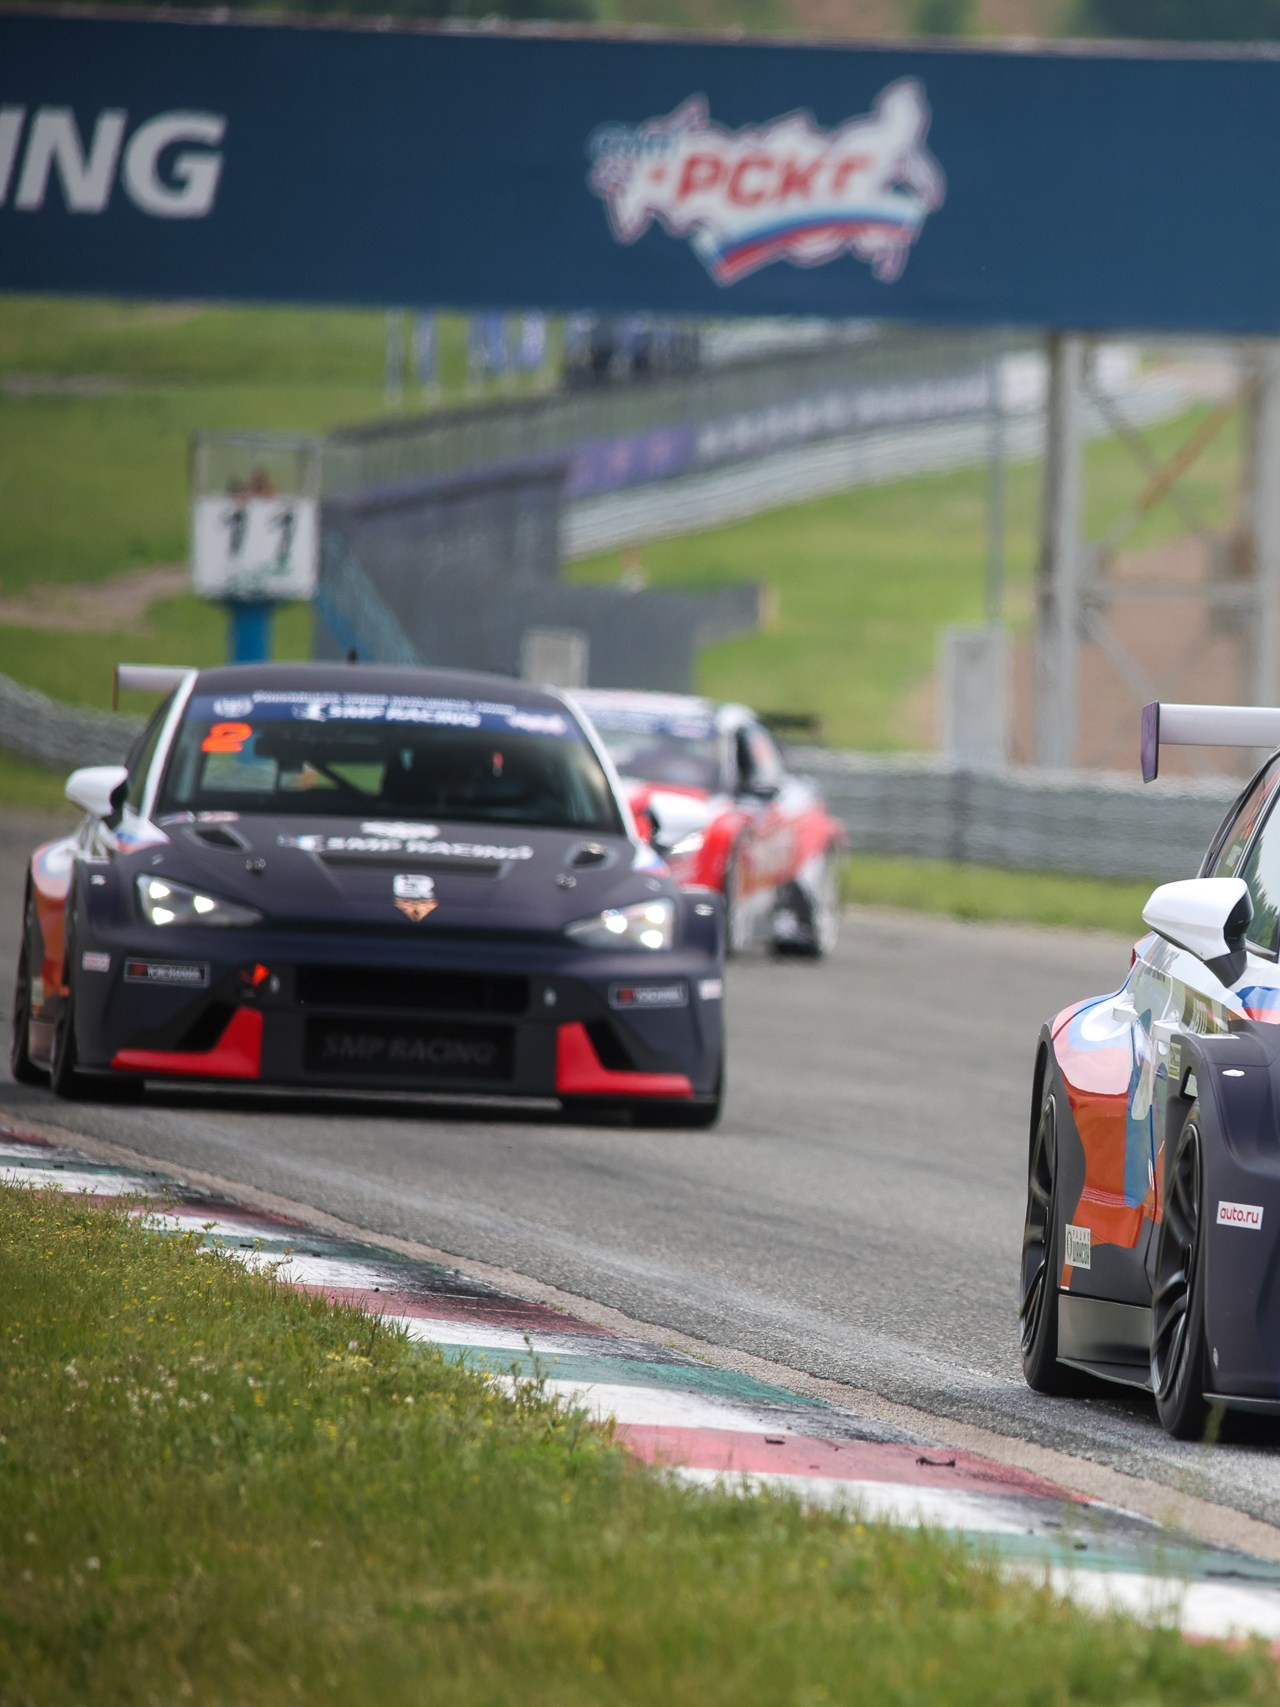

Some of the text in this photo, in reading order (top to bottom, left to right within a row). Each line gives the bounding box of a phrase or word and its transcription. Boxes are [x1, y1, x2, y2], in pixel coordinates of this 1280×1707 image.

[675, 152, 875, 207] РСКГ
[201, 722, 253, 753] 2
[1219, 1206, 1259, 1224] auto.ru
